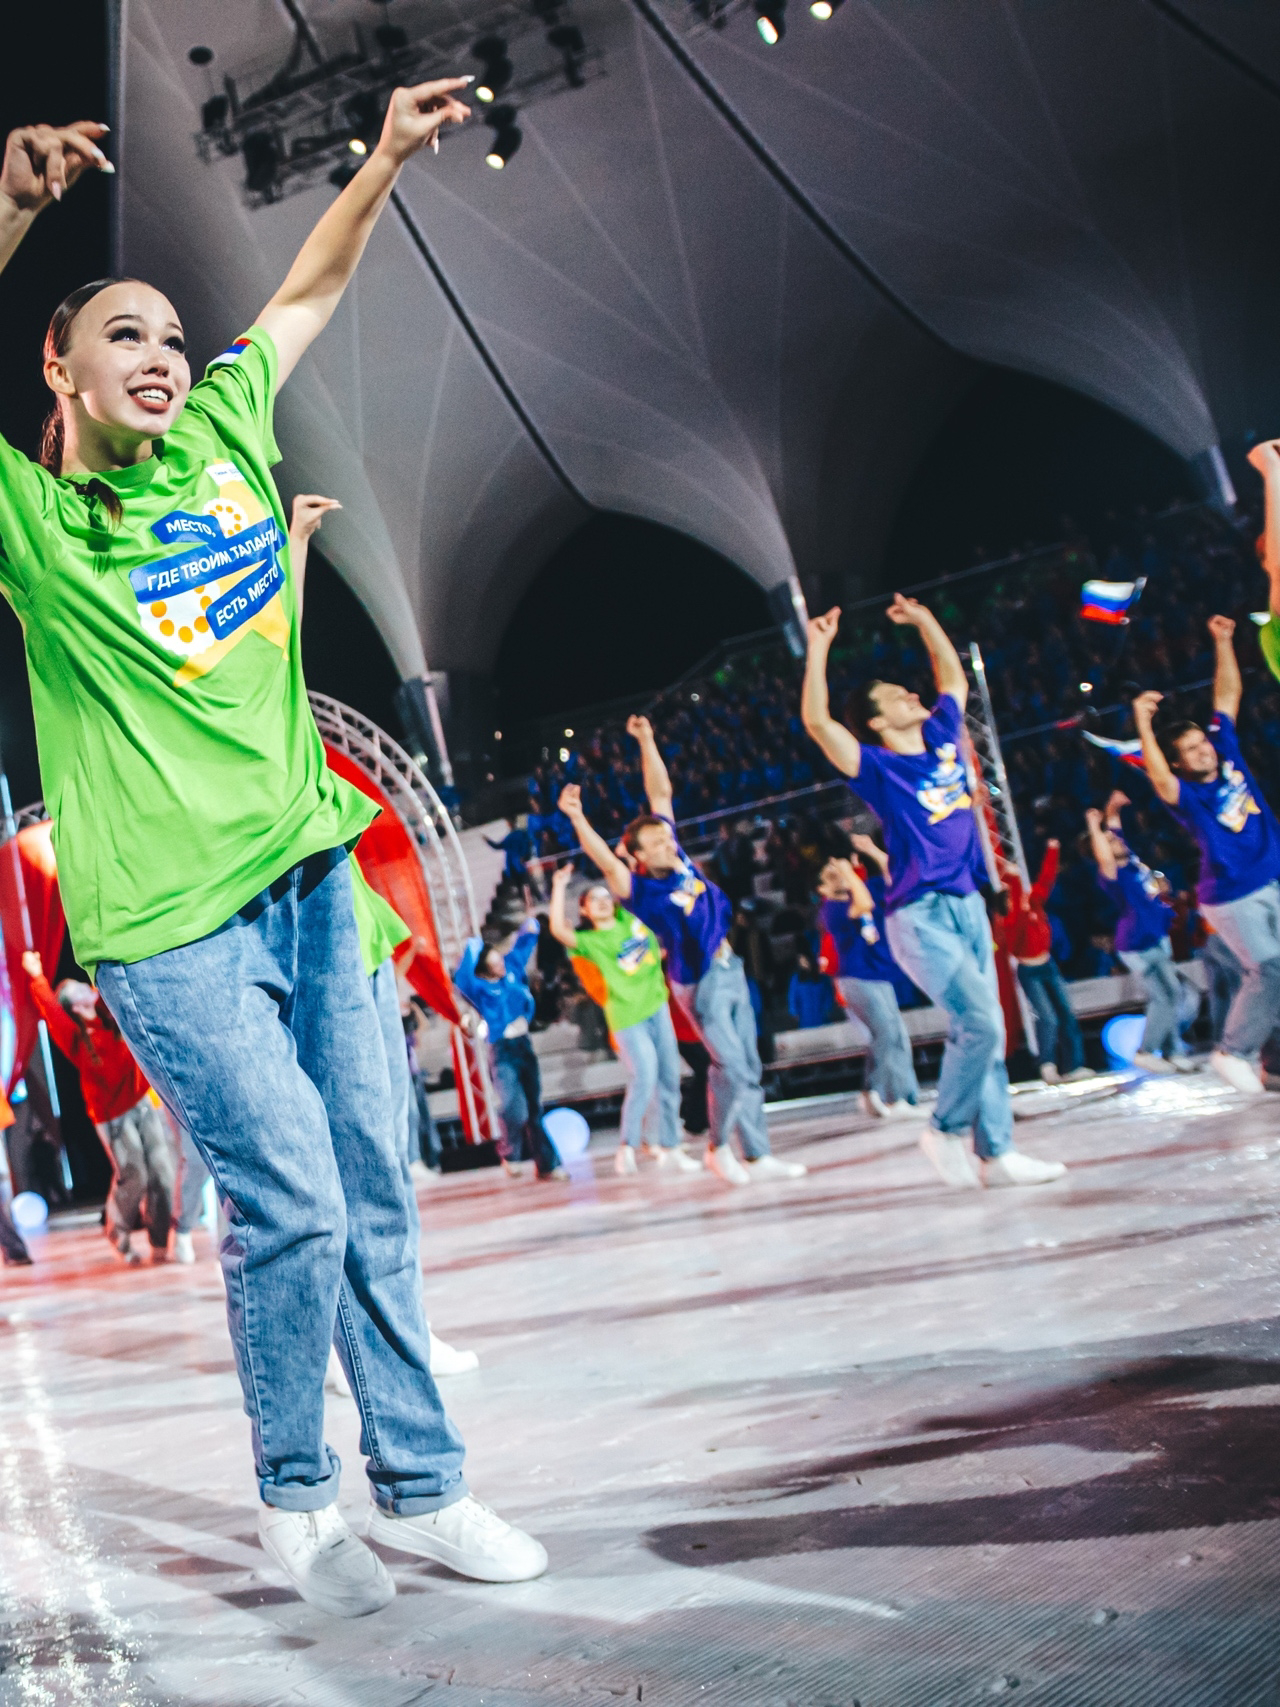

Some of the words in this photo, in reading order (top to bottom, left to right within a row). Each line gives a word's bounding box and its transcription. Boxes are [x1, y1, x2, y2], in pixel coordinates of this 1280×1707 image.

[165, 518, 217, 538] МЕСТО,
[147, 567, 181, 592] ГДЕ
[180, 550, 233, 580] ТВОИМ
[216, 595, 248, 627] ЕСТЬ
[247, 563, 279, 602] МЕСТО
